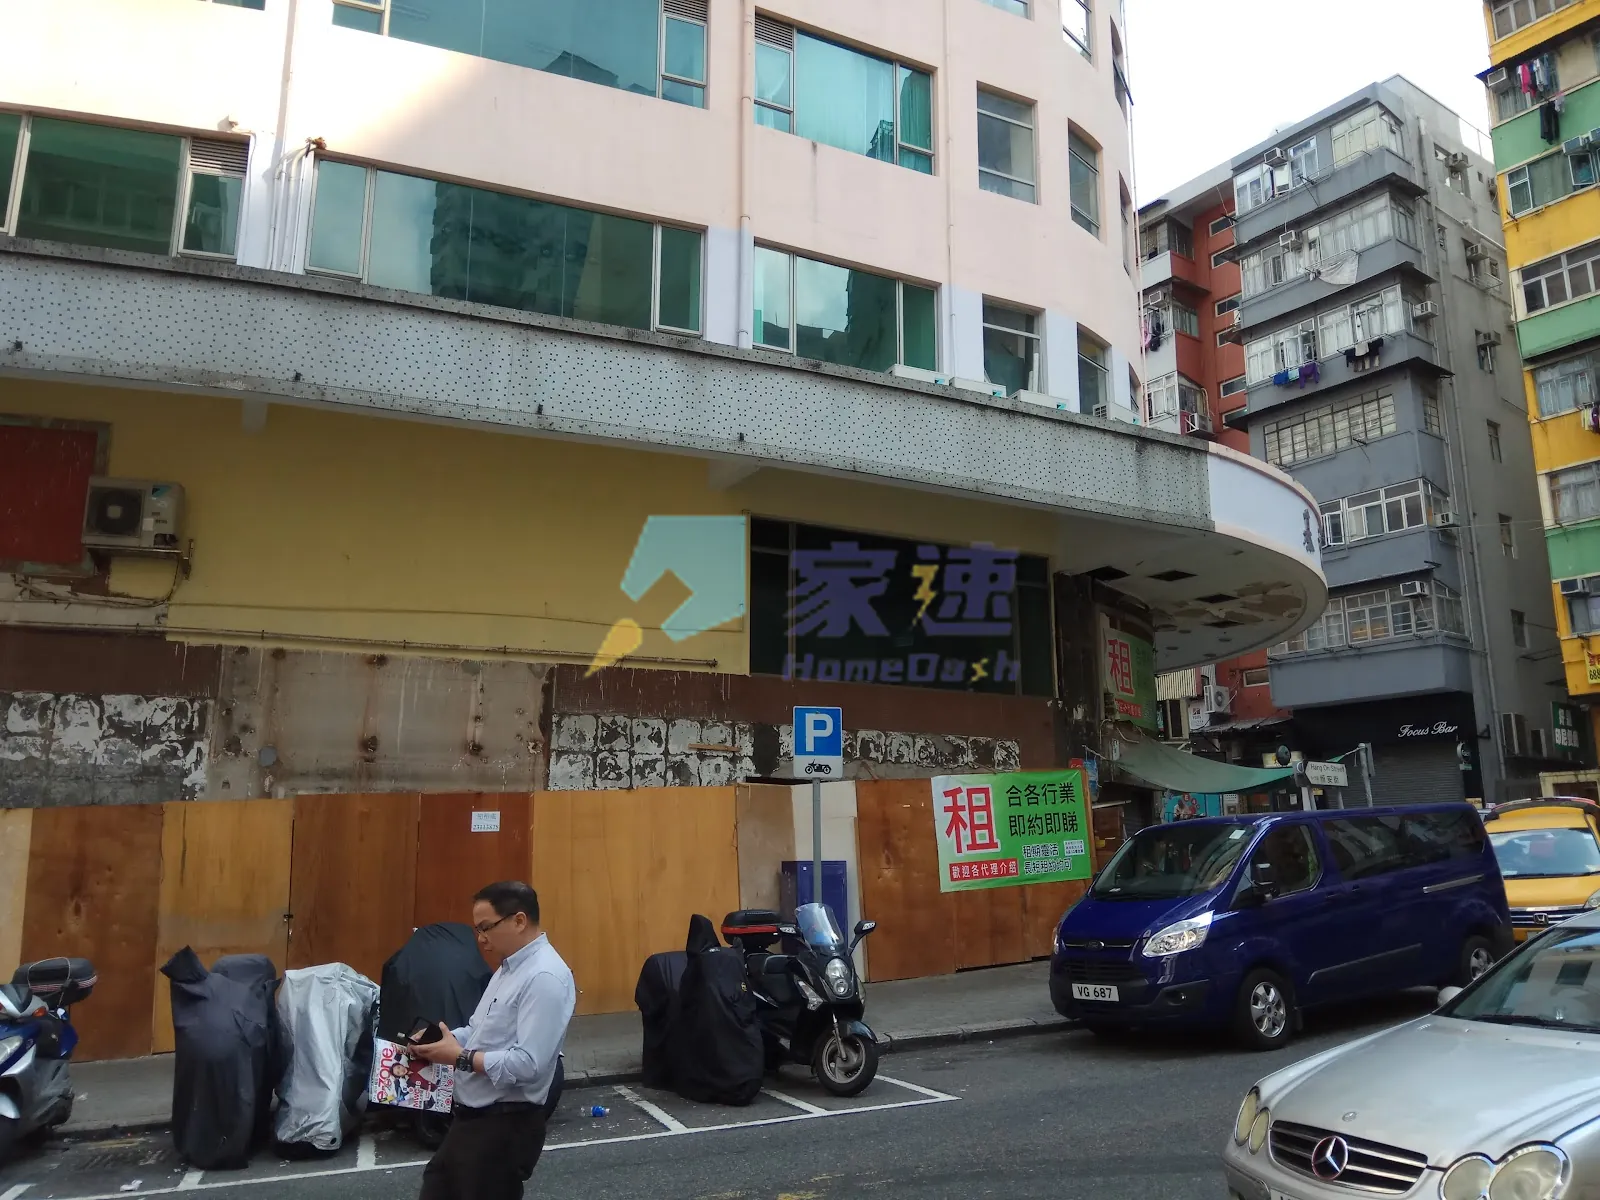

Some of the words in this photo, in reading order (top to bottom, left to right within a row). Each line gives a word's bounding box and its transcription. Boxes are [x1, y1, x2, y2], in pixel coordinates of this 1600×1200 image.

[1107, 638, 1134, 695] 租
[805, 713, 834, 752] P
[1397, 724, 1430, 738] Focus
[1432, 720, 1458, 736] Bar
[1310, 763, 1322, 772] Hang
[1331, 764, 1344, 773] Street
[1005, 782, 1076, 807] 合各行業
[943, 786, 999, 854] 租
[1008, 811, 1079, 837] 即約即睇
[951, 860, 1018, 879] 歡迎各代理介紹
[1077, 986, 1090, 997] VG
[1094, 987, 1112, 999] 687
[376, 1047, 394, 1102] e-zone
